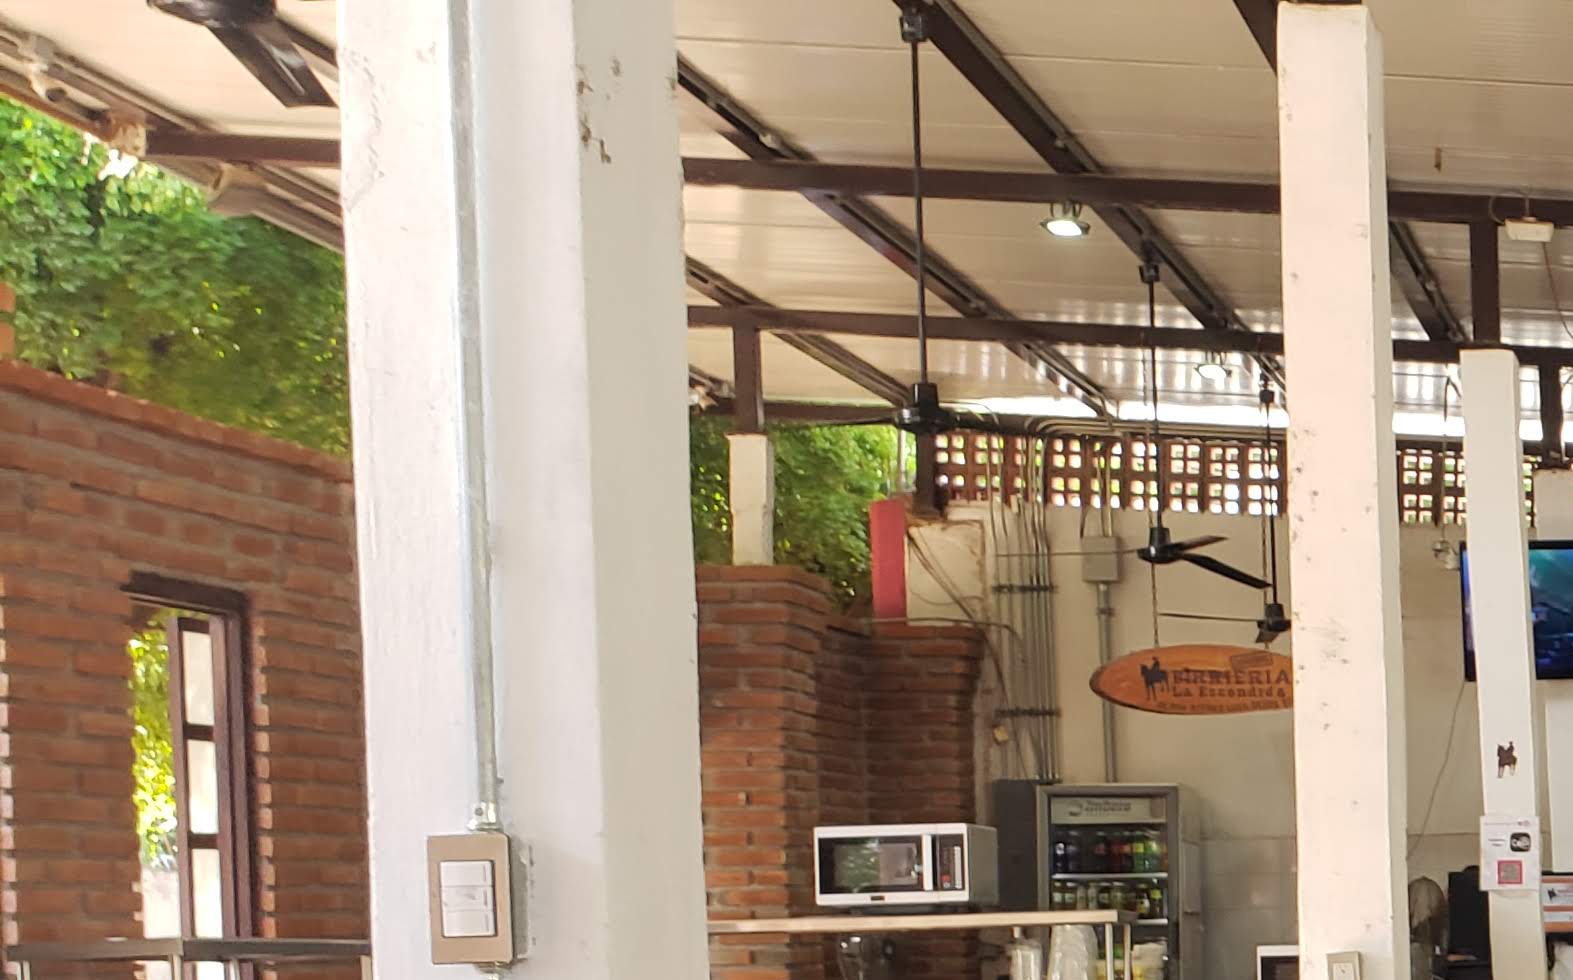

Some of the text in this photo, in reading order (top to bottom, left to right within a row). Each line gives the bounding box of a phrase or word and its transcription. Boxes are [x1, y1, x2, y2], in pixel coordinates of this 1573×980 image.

[1173, 669, 1291, 685] BIRRIERIA
[1173, 685, 1286, 698] La Escondida
